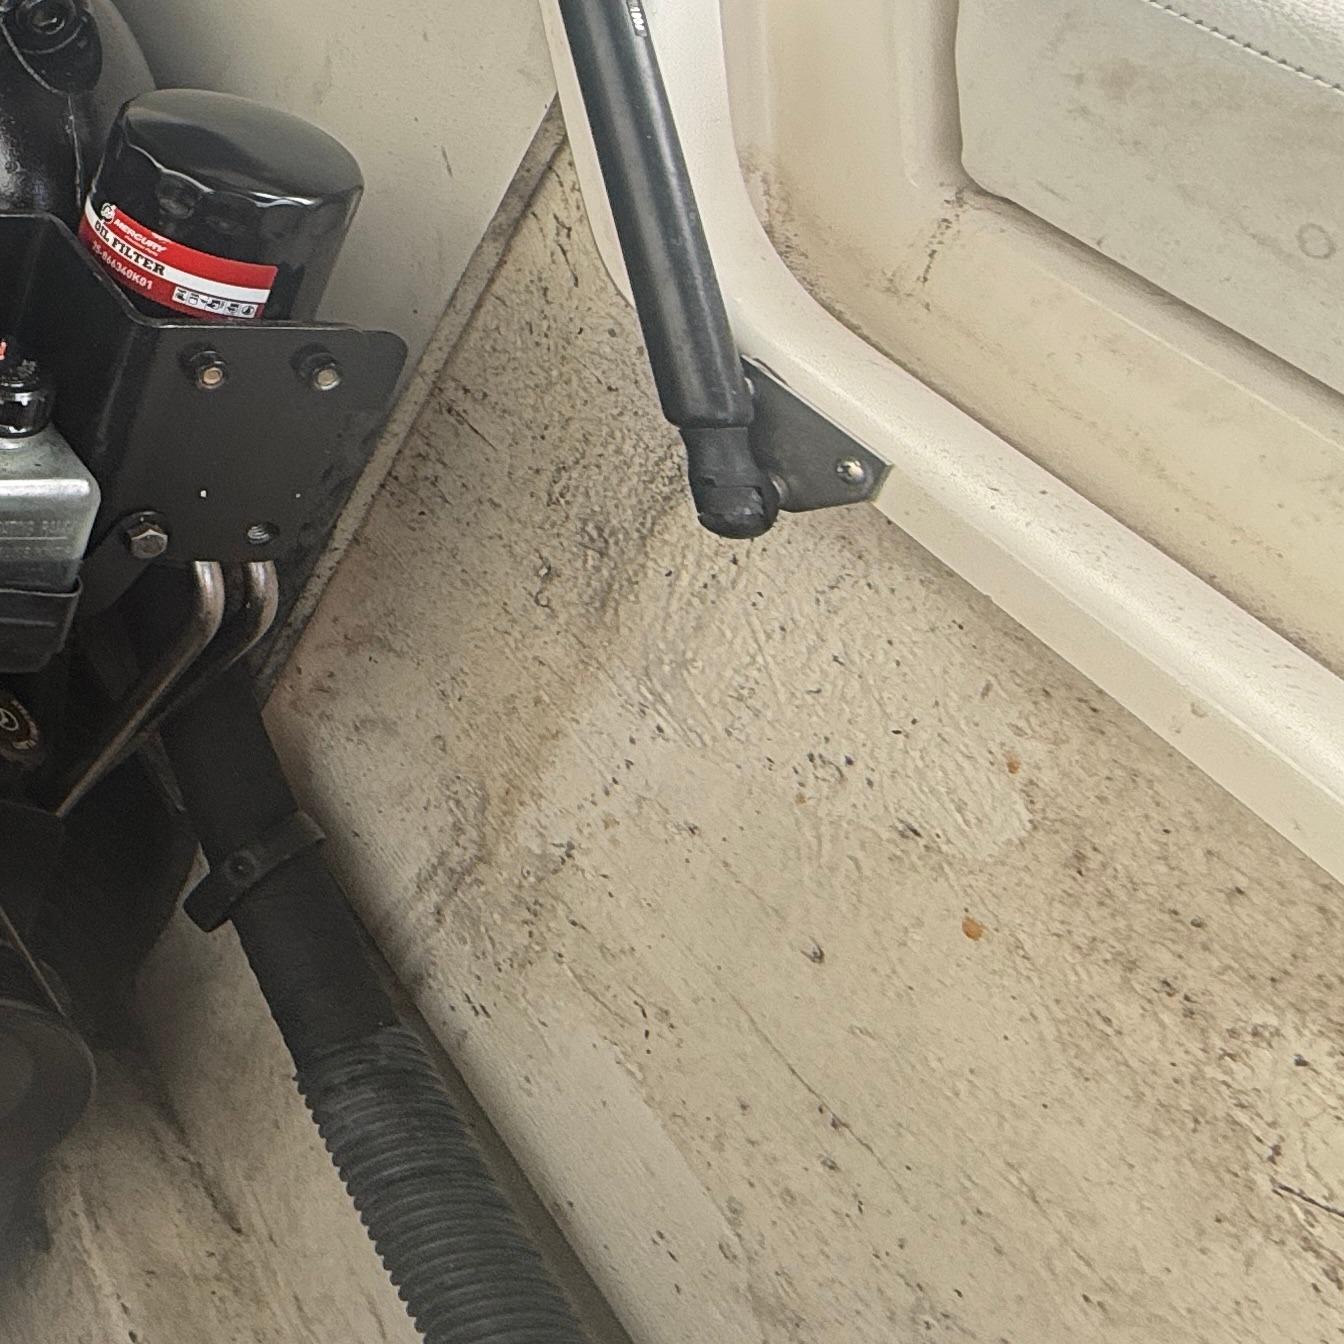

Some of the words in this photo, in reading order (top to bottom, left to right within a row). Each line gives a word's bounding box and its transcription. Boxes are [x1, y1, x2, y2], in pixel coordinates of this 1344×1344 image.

[95, 220, 109, 242] OIL
[112, 238, 166, 276] FILTER
[114, 218, 167, 253] MERCURY
